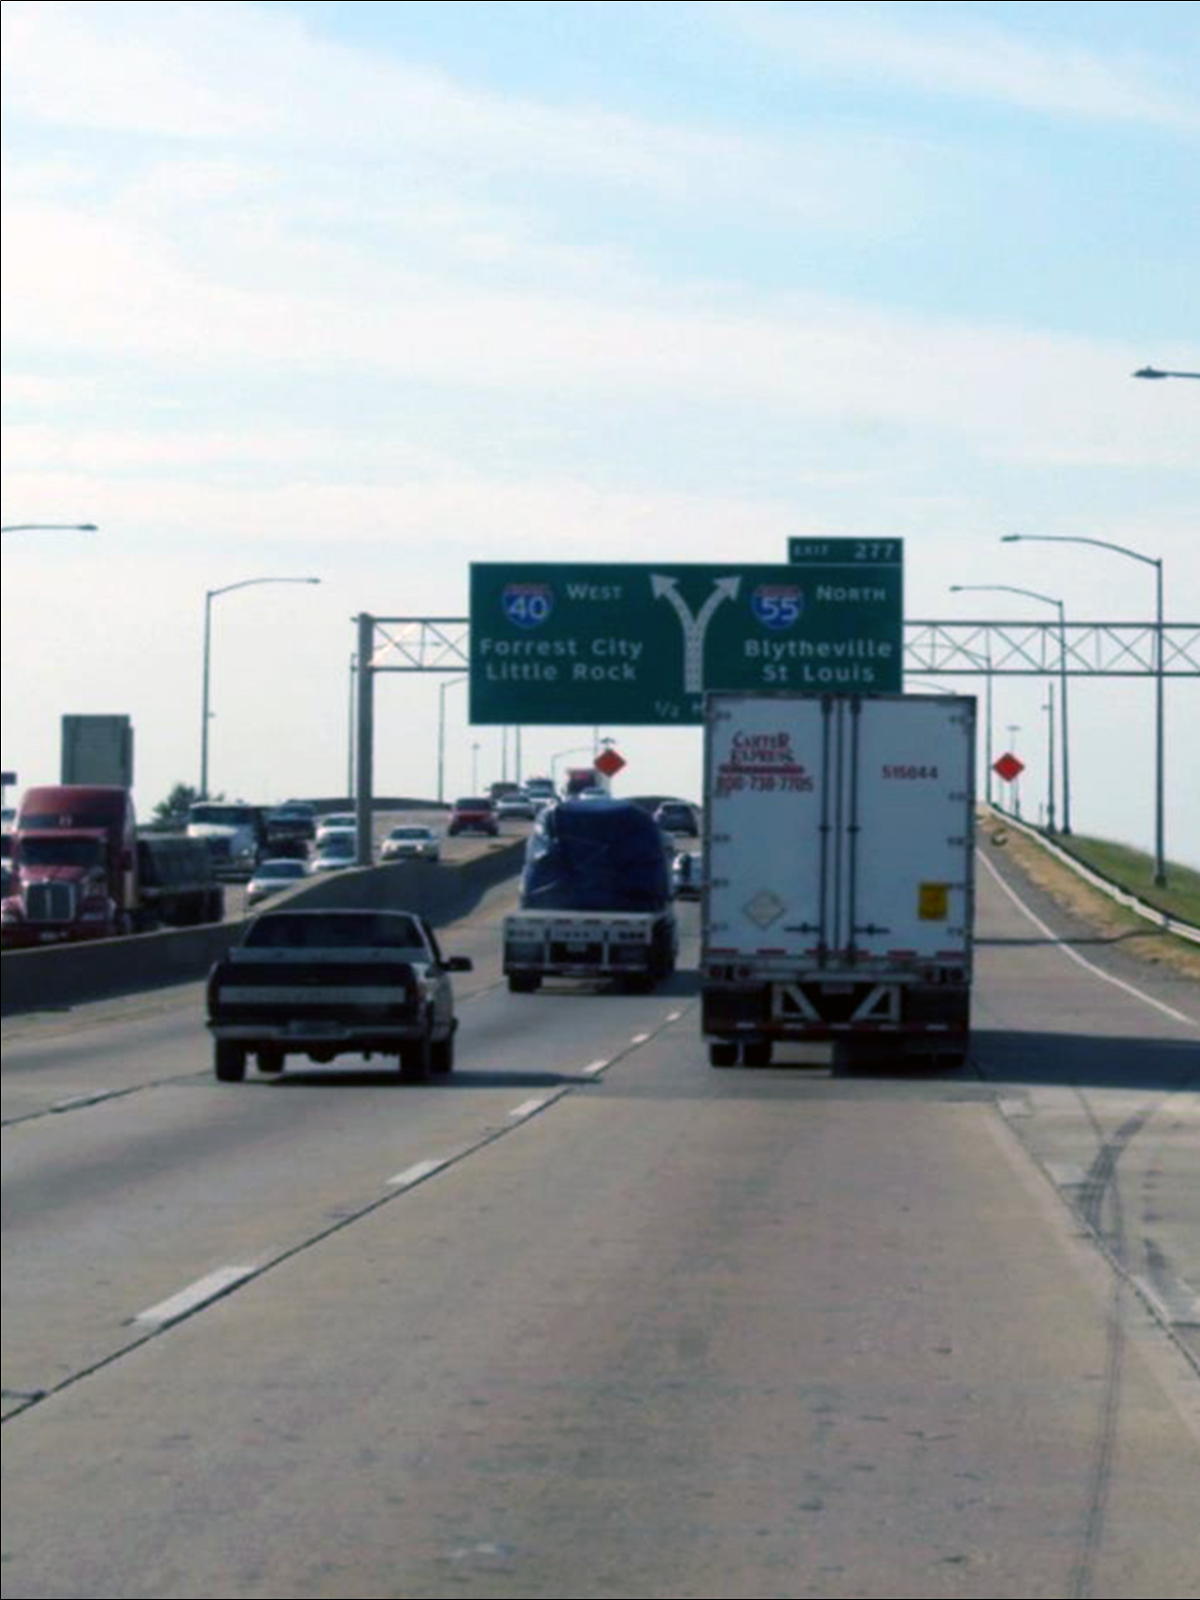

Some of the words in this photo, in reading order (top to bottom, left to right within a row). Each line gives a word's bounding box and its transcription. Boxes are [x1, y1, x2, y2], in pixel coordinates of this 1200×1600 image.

[793, 544, 829, 556] EXIT
[854, 542, 894, 560] 277
[507, 595, 548, 621] 40
[565, 583, 622, 601] WEST
[760, 596, 800, 623] 55
[815, 584, 887, 602] NORTH
[479, 638, 578, 657] Forrest
[592, 638, 644, 661] City
[744, 638, 893, 663] Blytheville
[485, 662, 559, 682] Little
[573, 662, 638, 682] Rock
[762, 664, 789, 684] St
[803, 664, 876, 684] Louis
